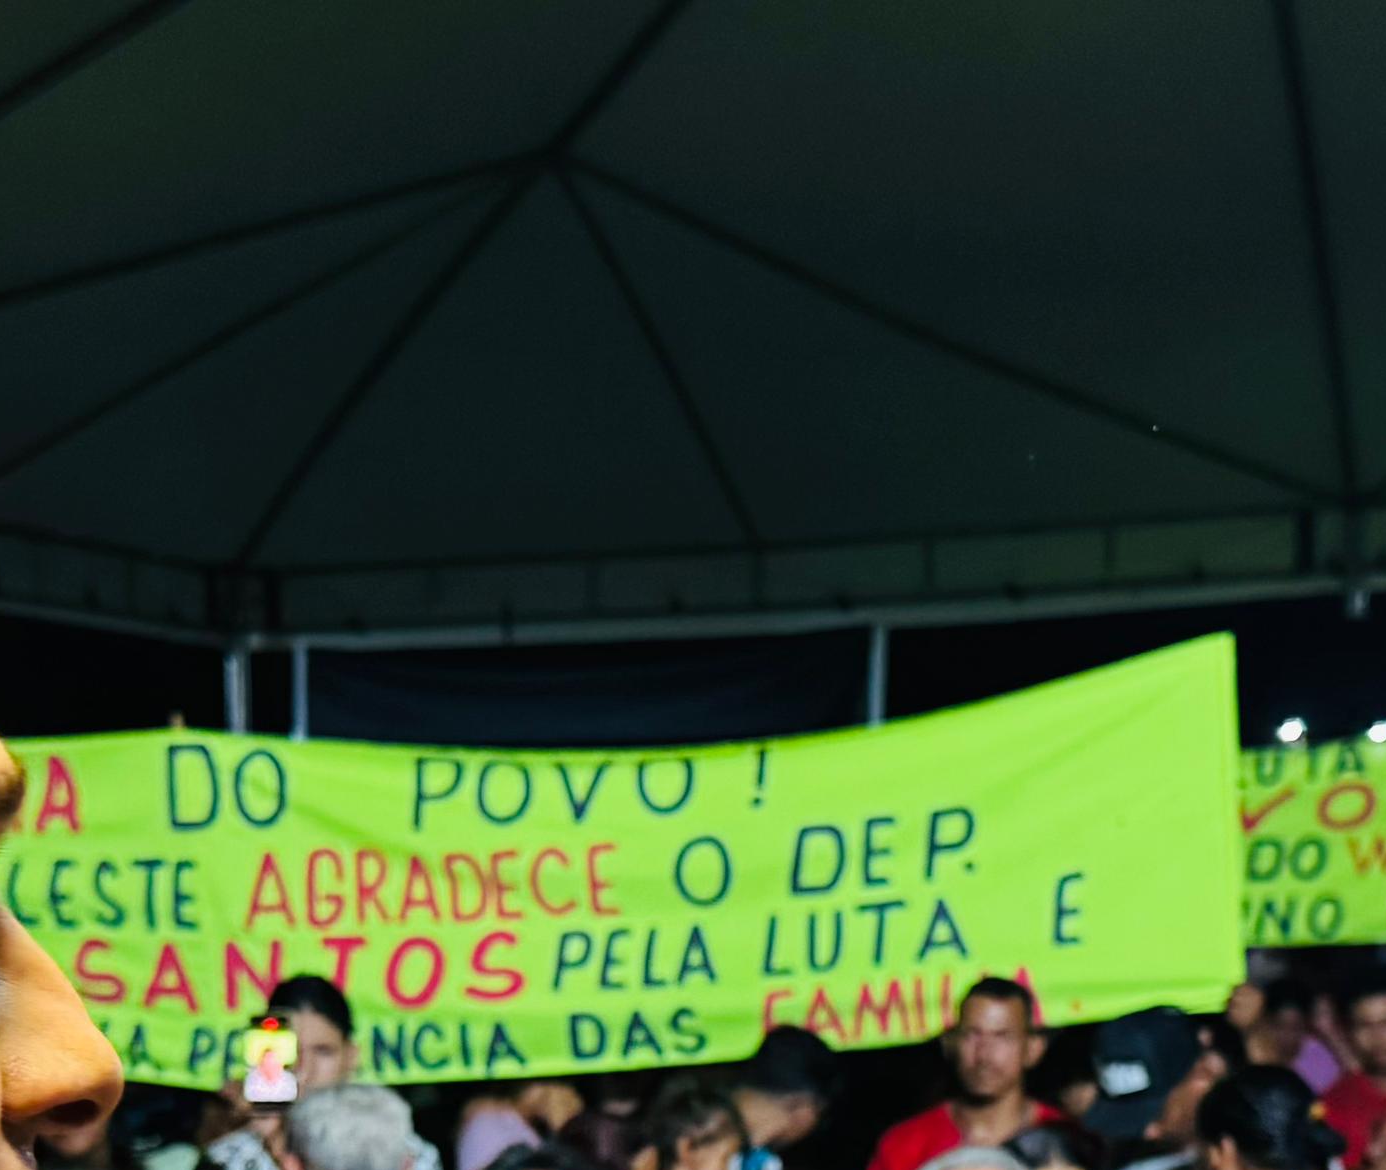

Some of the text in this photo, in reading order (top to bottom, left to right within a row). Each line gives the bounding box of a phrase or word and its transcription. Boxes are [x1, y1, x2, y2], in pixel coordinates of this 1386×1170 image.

[166, 744, 289, 830] DO
[1238, 740, 1365, 787] UTA
[6, 807, 977, 930] LESTE AGRADECE O DEP.
[74, 871, 1084, 1014] SANTOS PELA LUTA E
[1241, 893, 1344, 944] NO
[570, 1006, 707, 1061] DAS
